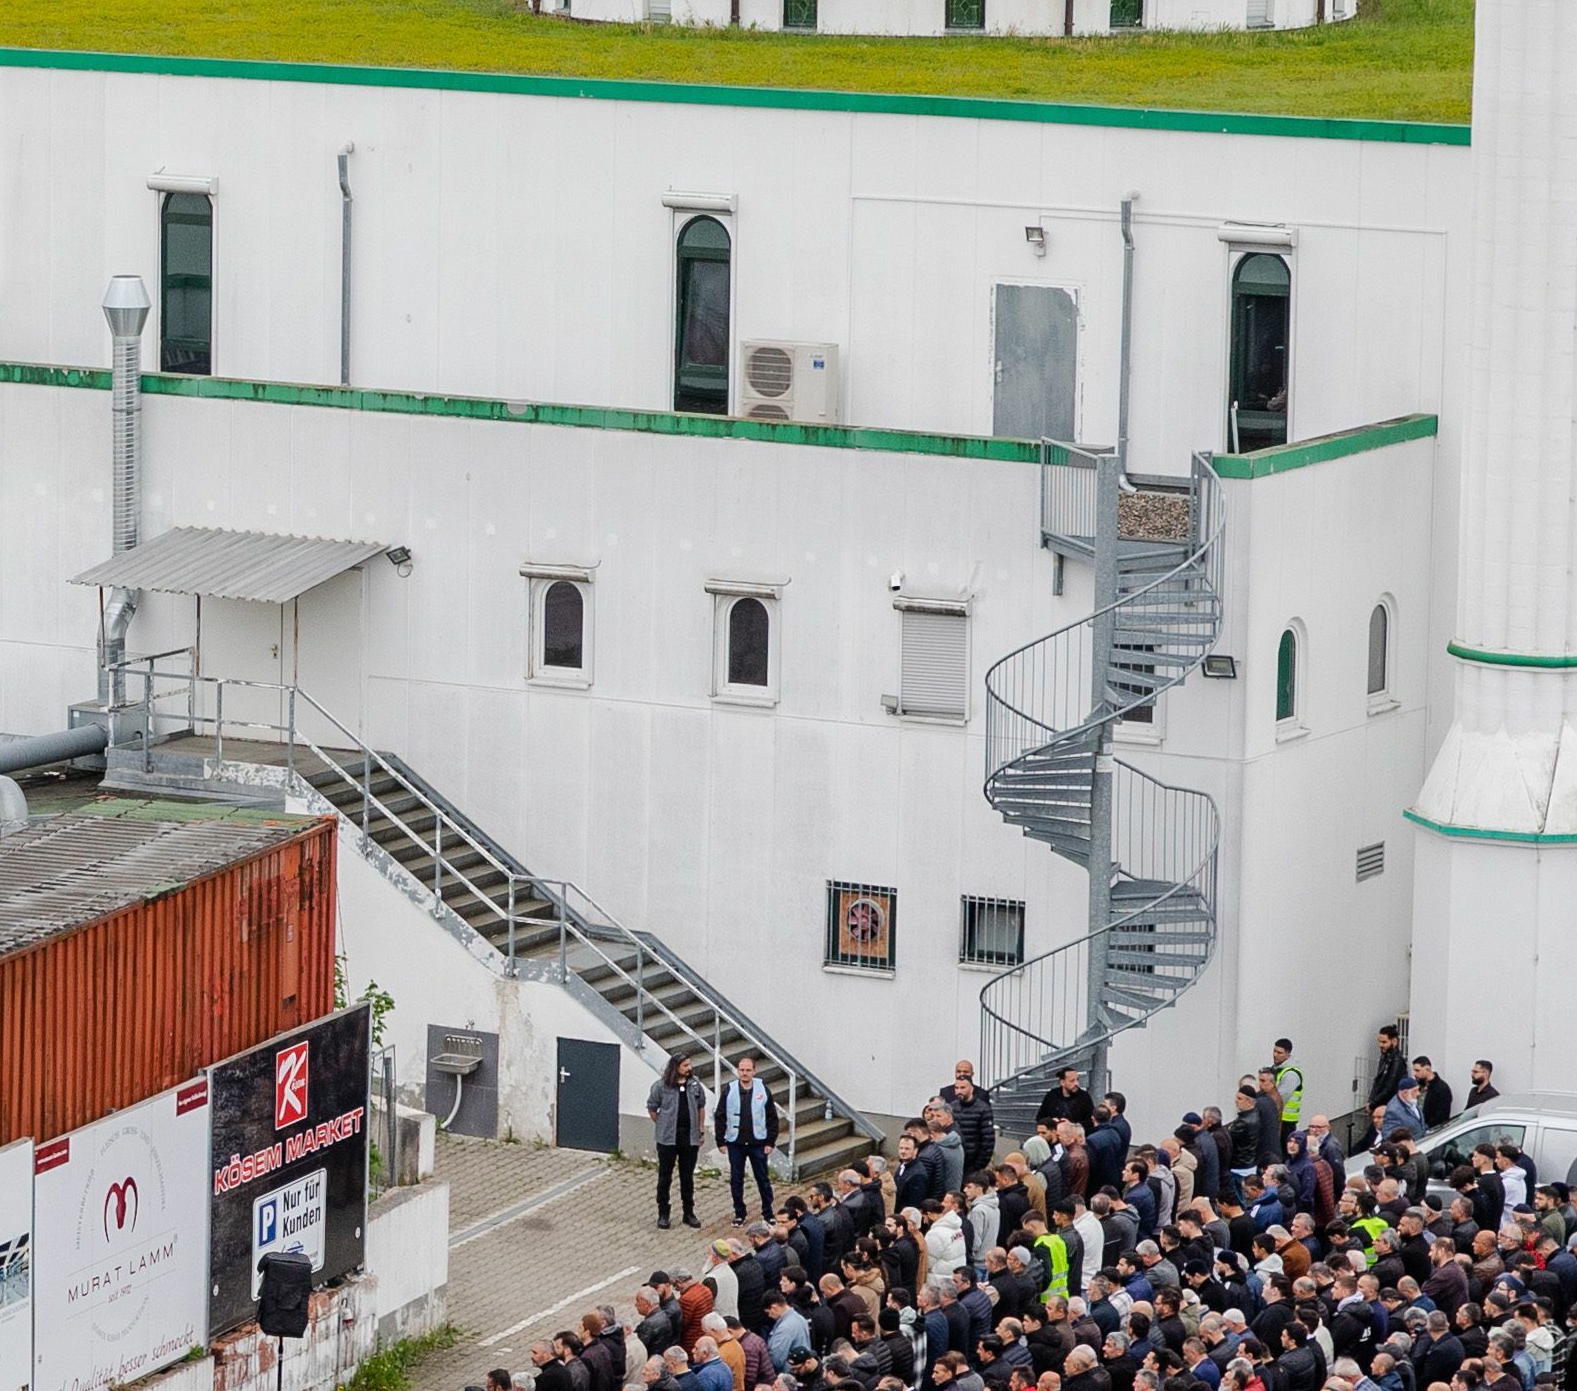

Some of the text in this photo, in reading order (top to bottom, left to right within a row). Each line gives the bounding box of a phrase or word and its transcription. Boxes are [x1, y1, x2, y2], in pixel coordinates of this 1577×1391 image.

[214, 1106, 364, 1196] KÖSEM MARKET
[282, 1205, 322, 1239] Kunden
[283, 1178, 321, 1215] Nur für
[67, 1243, 174, 1304] MURAT LAMM
[118, 1353, 148, 1381] besser
[151, 1322, 195, 1362] schmeckt
